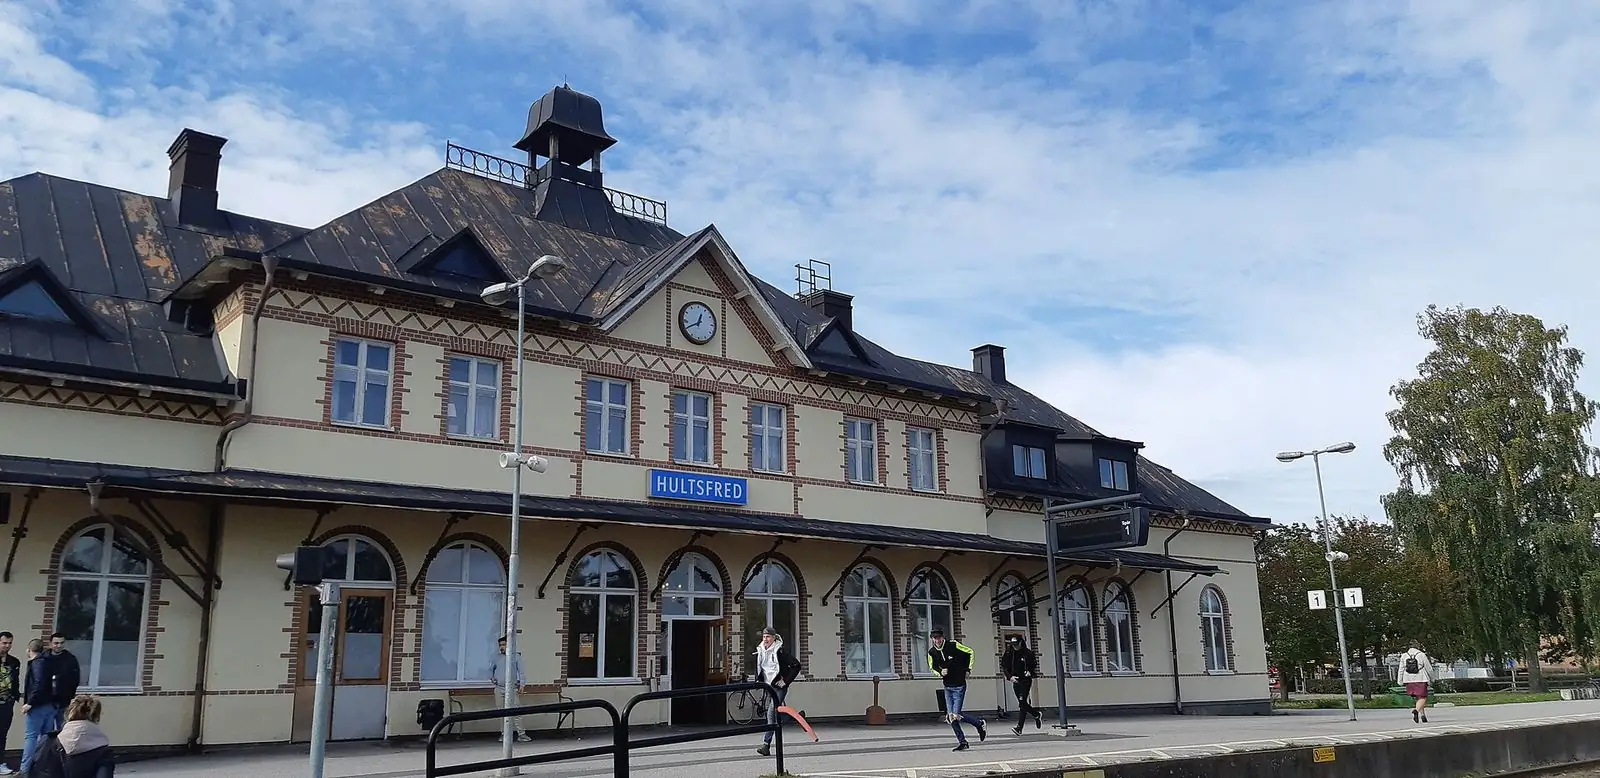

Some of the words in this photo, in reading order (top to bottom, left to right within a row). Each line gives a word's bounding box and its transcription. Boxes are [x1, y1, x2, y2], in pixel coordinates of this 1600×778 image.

[657, 475, 742, 499] HULTSFRED
[1125, 526, 1130, 536] 1
[1314, 596, 1320, 607] 1
[1350, 594, 1356, 605] 1
